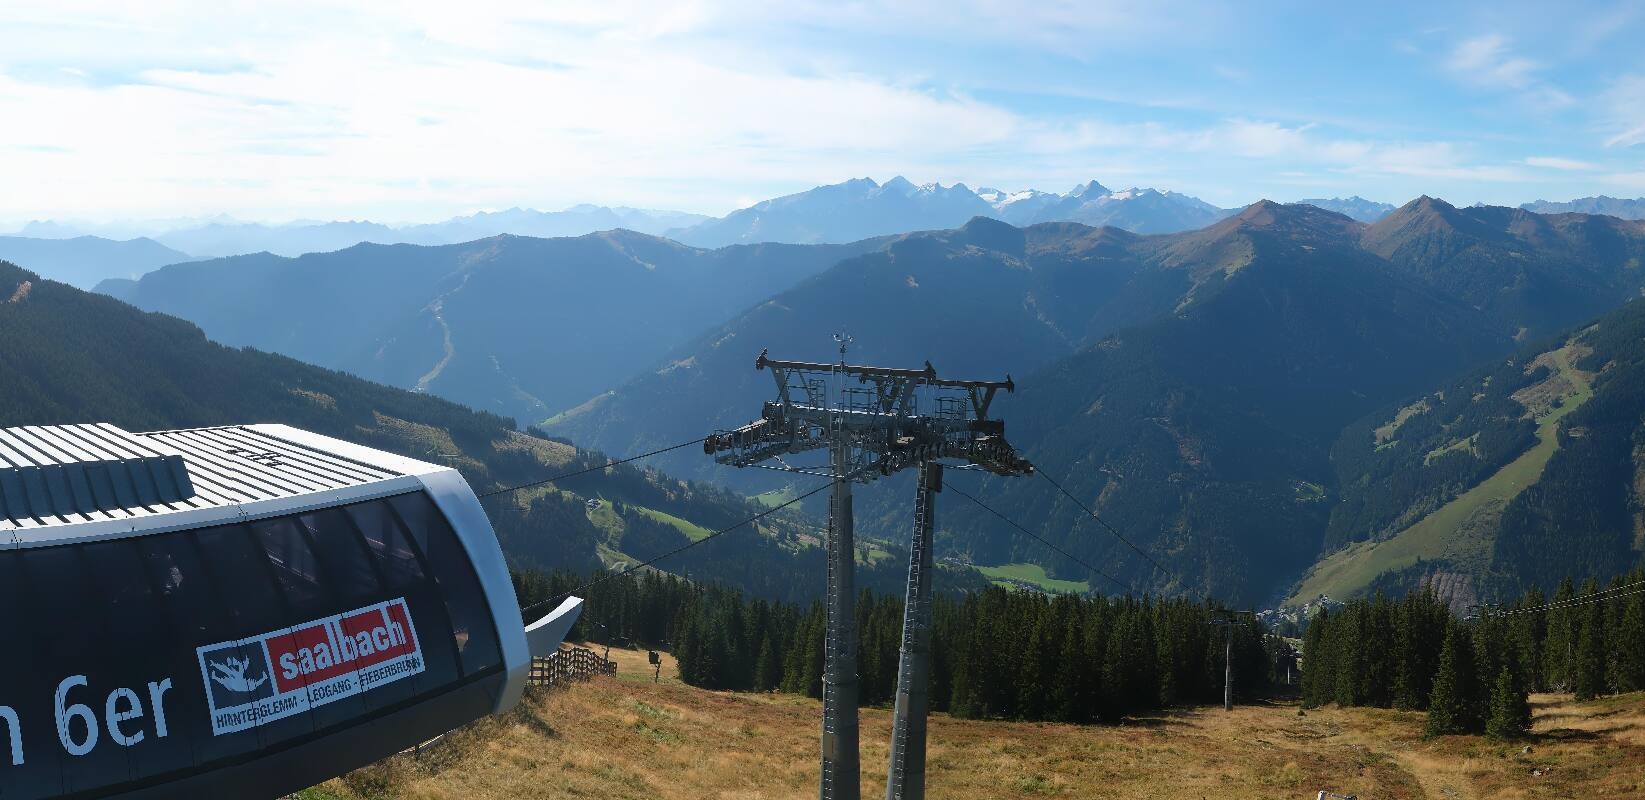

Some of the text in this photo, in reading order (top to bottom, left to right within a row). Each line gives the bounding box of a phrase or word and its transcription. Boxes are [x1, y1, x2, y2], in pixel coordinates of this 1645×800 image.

[277, 607, 407, 682] saalbach
[307, 679, 352, 704] LEOGANG
[360, 656, 422, 687] FIEBERBRUNN
[54, 674, 173, 756] 6er
